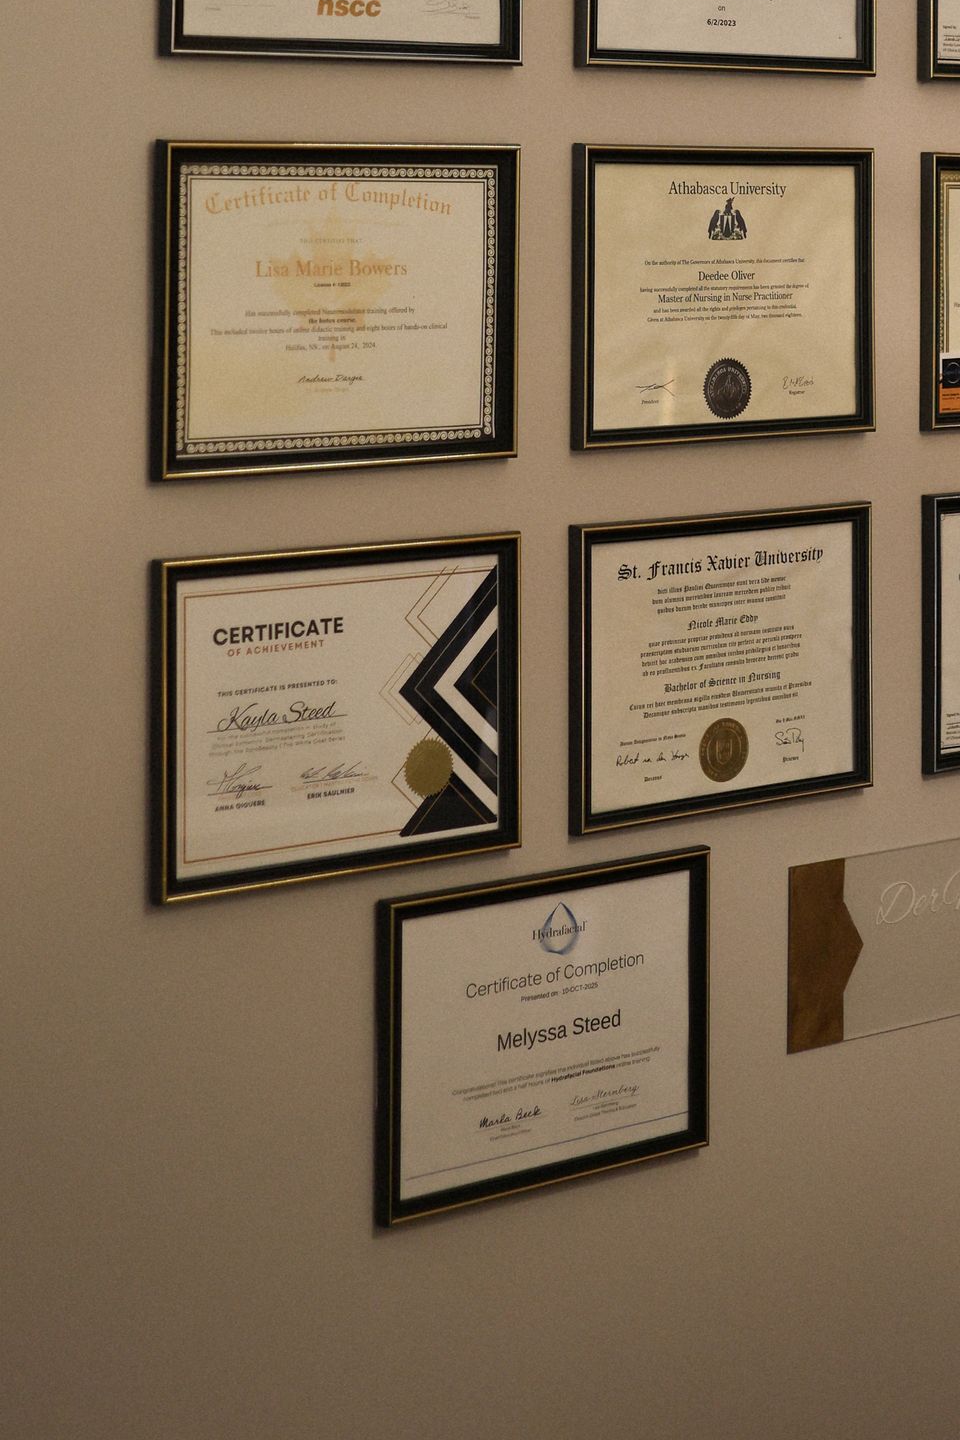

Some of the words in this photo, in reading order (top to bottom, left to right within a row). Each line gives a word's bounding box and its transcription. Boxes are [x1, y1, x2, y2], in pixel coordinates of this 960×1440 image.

[668, 180, 728, 195] Athabasca
[729, 181, 787, 199] University
[255, 259, 289, 278] Lisa
[295, 259, 343, 277] Marie
[349, 259, 408, 276] Bowers
[698, 270, 729, 282] Deedee
[730, 270, 756, 280] Oliver
[658, 294, 684, 304] Master
[684, 293, 693, 303] of
[692, 293, 722, 303] Nursing
[723, 292, 731, 302] in
[732, 292, 752, 302] Nurse
[753, 291, 793, 301] Practitioner
[617, 563, 641, 581] St.
[646, 560, 702, 581] Francis
[706, 554, 751, 572] Xavier
[754, 547, 824, 567] University
[212, 616, 344, 646] CERTIFICATE
[226, 647, 241, 658] OF
[246, 639, 324, 655] ACHIEVEMENT
[215, 702, 279, 733] Kayla
[282, 700, 338, 724] Steed
[465, 973, 542, 999] Certificate
[546, 966, 561, 984] of
[563, 953, 644, 980] Completion
[497, 1024, 568, 1052] Melyssa
[572, 1008, 621, 1036] Steed
